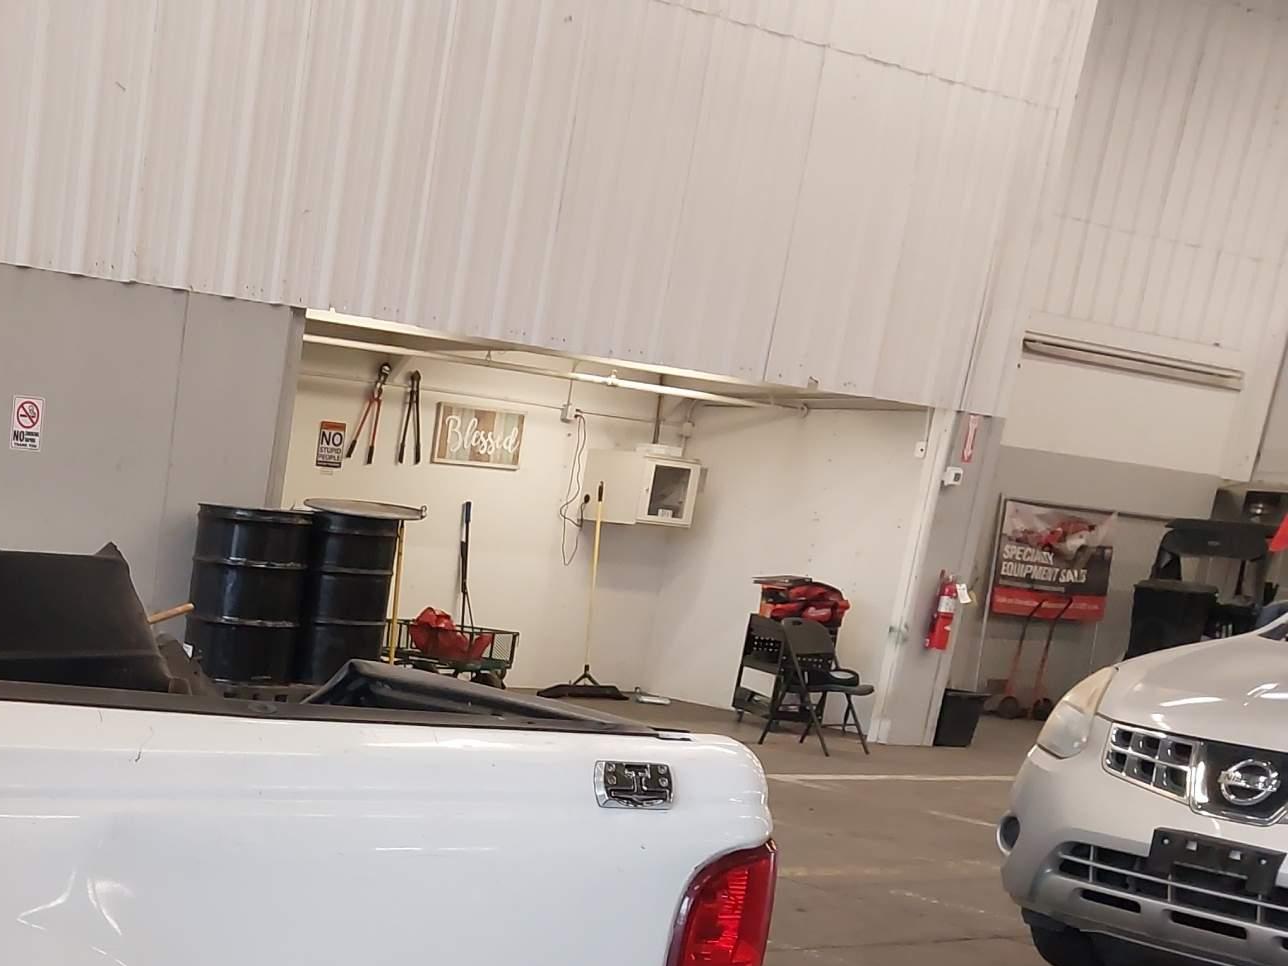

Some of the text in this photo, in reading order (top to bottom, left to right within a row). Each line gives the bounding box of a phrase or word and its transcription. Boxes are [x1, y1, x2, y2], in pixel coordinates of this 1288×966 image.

[13, 430, 25, 442] NO
[320, 430, 343, 447] NO
[445, 415, 519, 455] Blessed
[1000, 561, 1060, 582] EQUIPMENT
